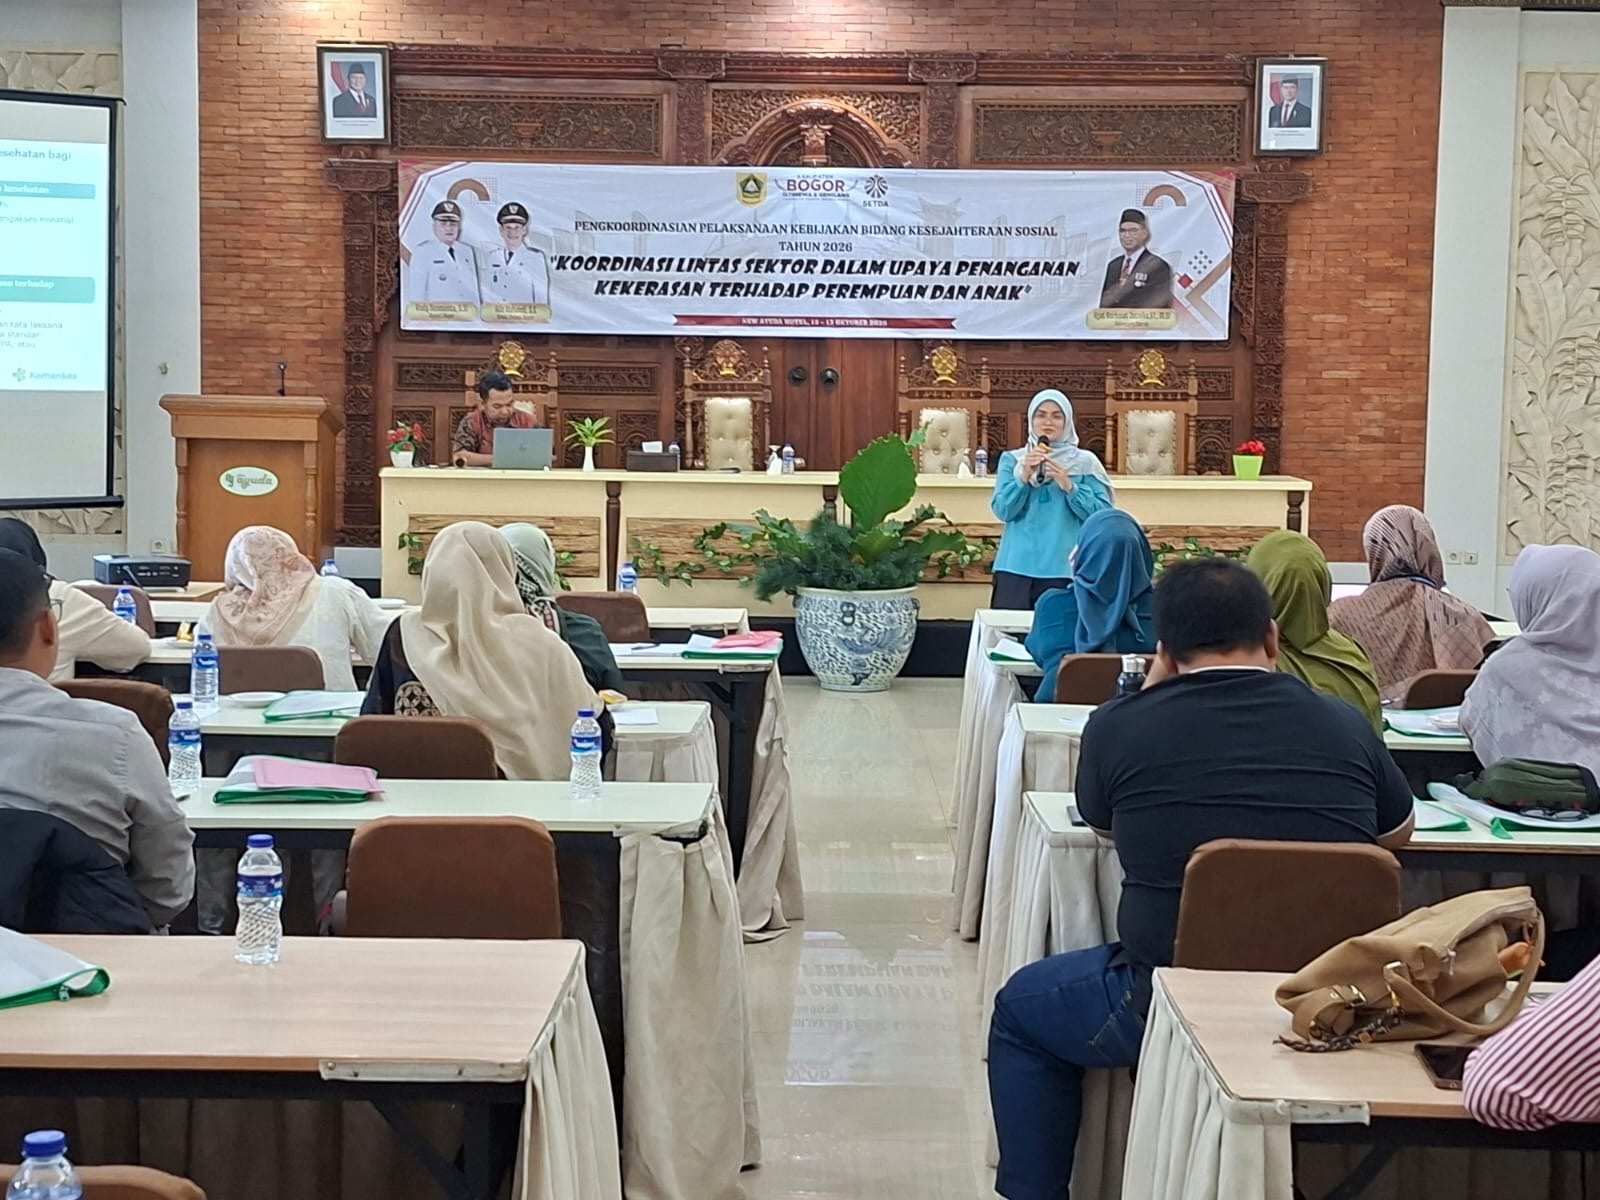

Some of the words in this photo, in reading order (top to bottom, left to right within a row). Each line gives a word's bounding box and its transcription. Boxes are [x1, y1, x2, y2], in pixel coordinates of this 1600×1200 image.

[0, 147, 45, 159] esehatan
[48, 149, 71, 161] bagi
[786, 179, 845, 192] BOGOR
[862, 200, 889, 208] SETDA
[574, 221, 697, 233] PENGKOORDINASIAN
[699, 223, 788, 235] PELAKSANAAN
[790, 224, 859, 236] KEBIJAKAN
[861, 225, 906, 236] BIDANG
[908, 225, 1012, 237] KESEJAHTERAAN
[1014, 227, 1058, 237] SOSIAL
[779, 241, 821, 252] TAHUN
[823, 242, 853, 252] 2026
[676, 257, 742, 273] LINTAS
[744, 258, 818, 275] SEKTOR
[820, 259, 887, 275] DALAM
[889, 260, 952, 276] UPAYA
[955, 261, 1080, 277] PENANGANAN
[594, 280, 706, 296] KEKERASAN
[708, 282, 810, 299] TERHADAP
[812, 283, 929, 300] PEREMPUAN
[929, 285, 970, 300] DAN
[10, 321, 28, 329] tata
[30, 320, 63, 329] laksana
